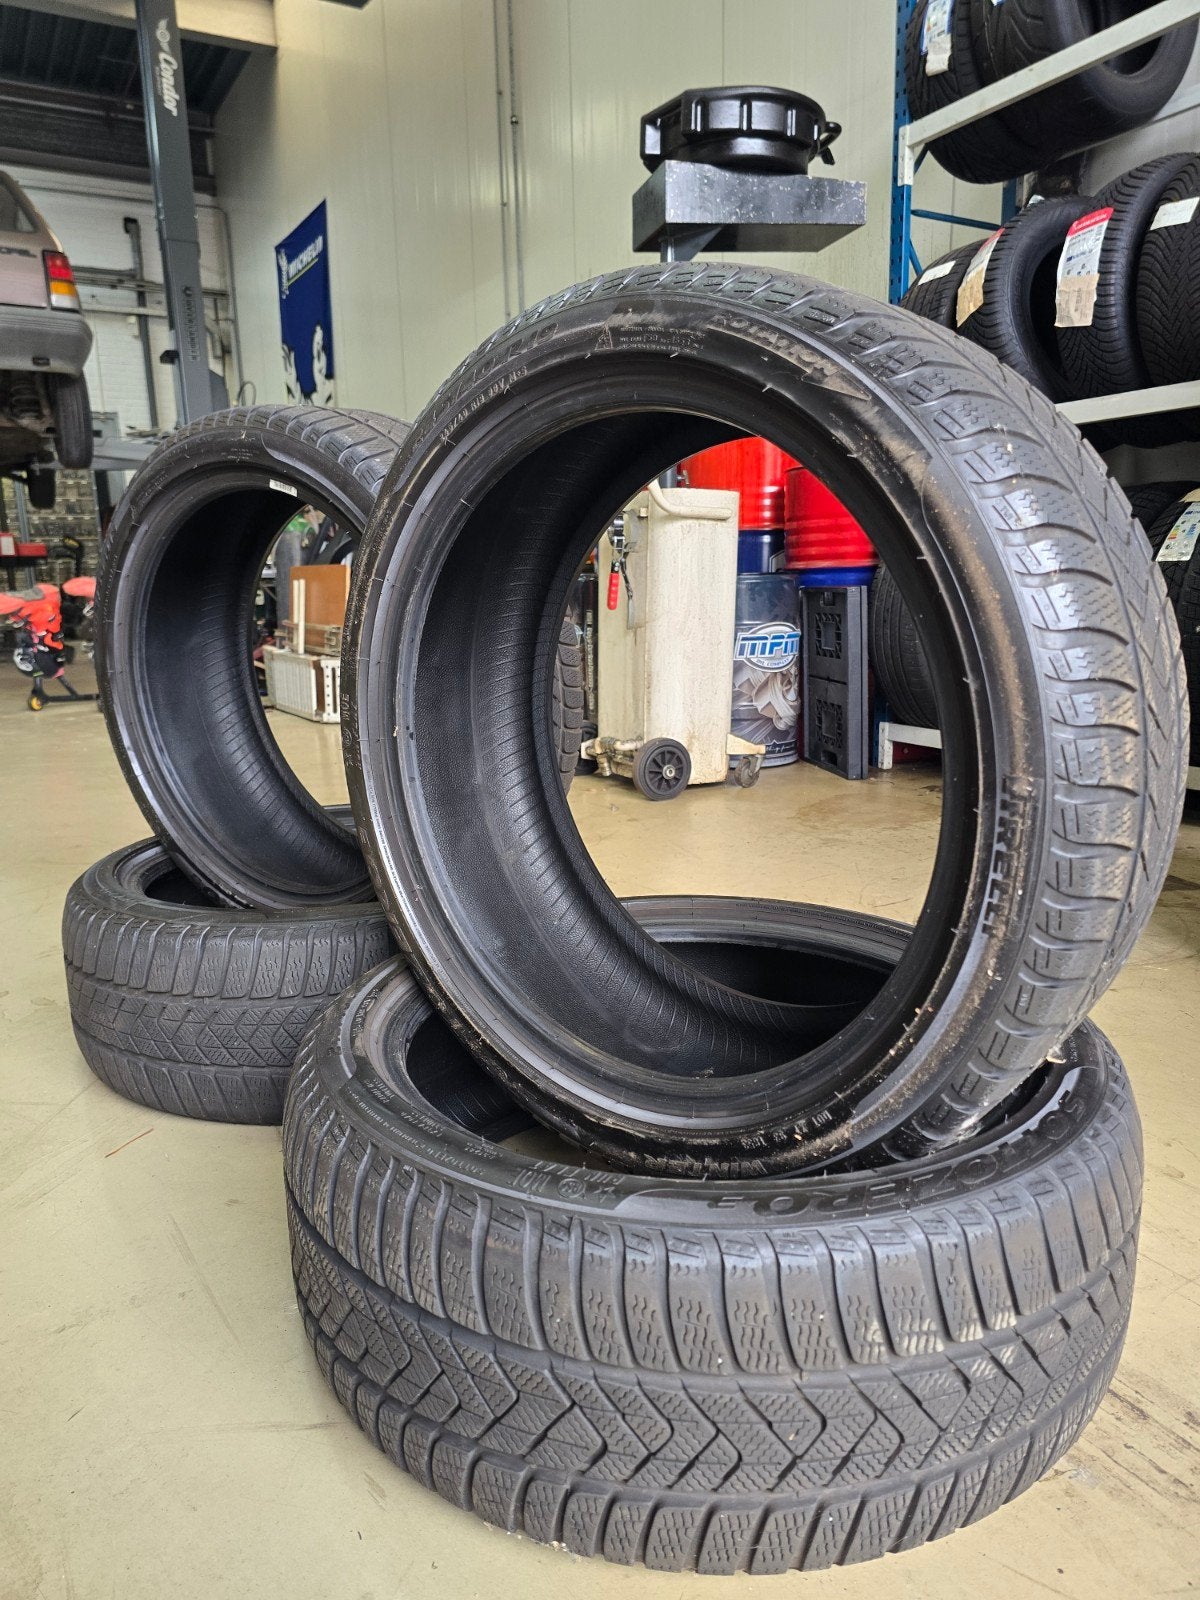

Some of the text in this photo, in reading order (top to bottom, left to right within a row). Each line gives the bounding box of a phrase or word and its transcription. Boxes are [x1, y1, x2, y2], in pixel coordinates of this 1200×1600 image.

[158, 51, 179, 117] Condor
[287, 235, 323, 280] MICHELIN
[706, 313, 842, 379] ROTATION
[642, 1152, 768, 1180] WINTER
